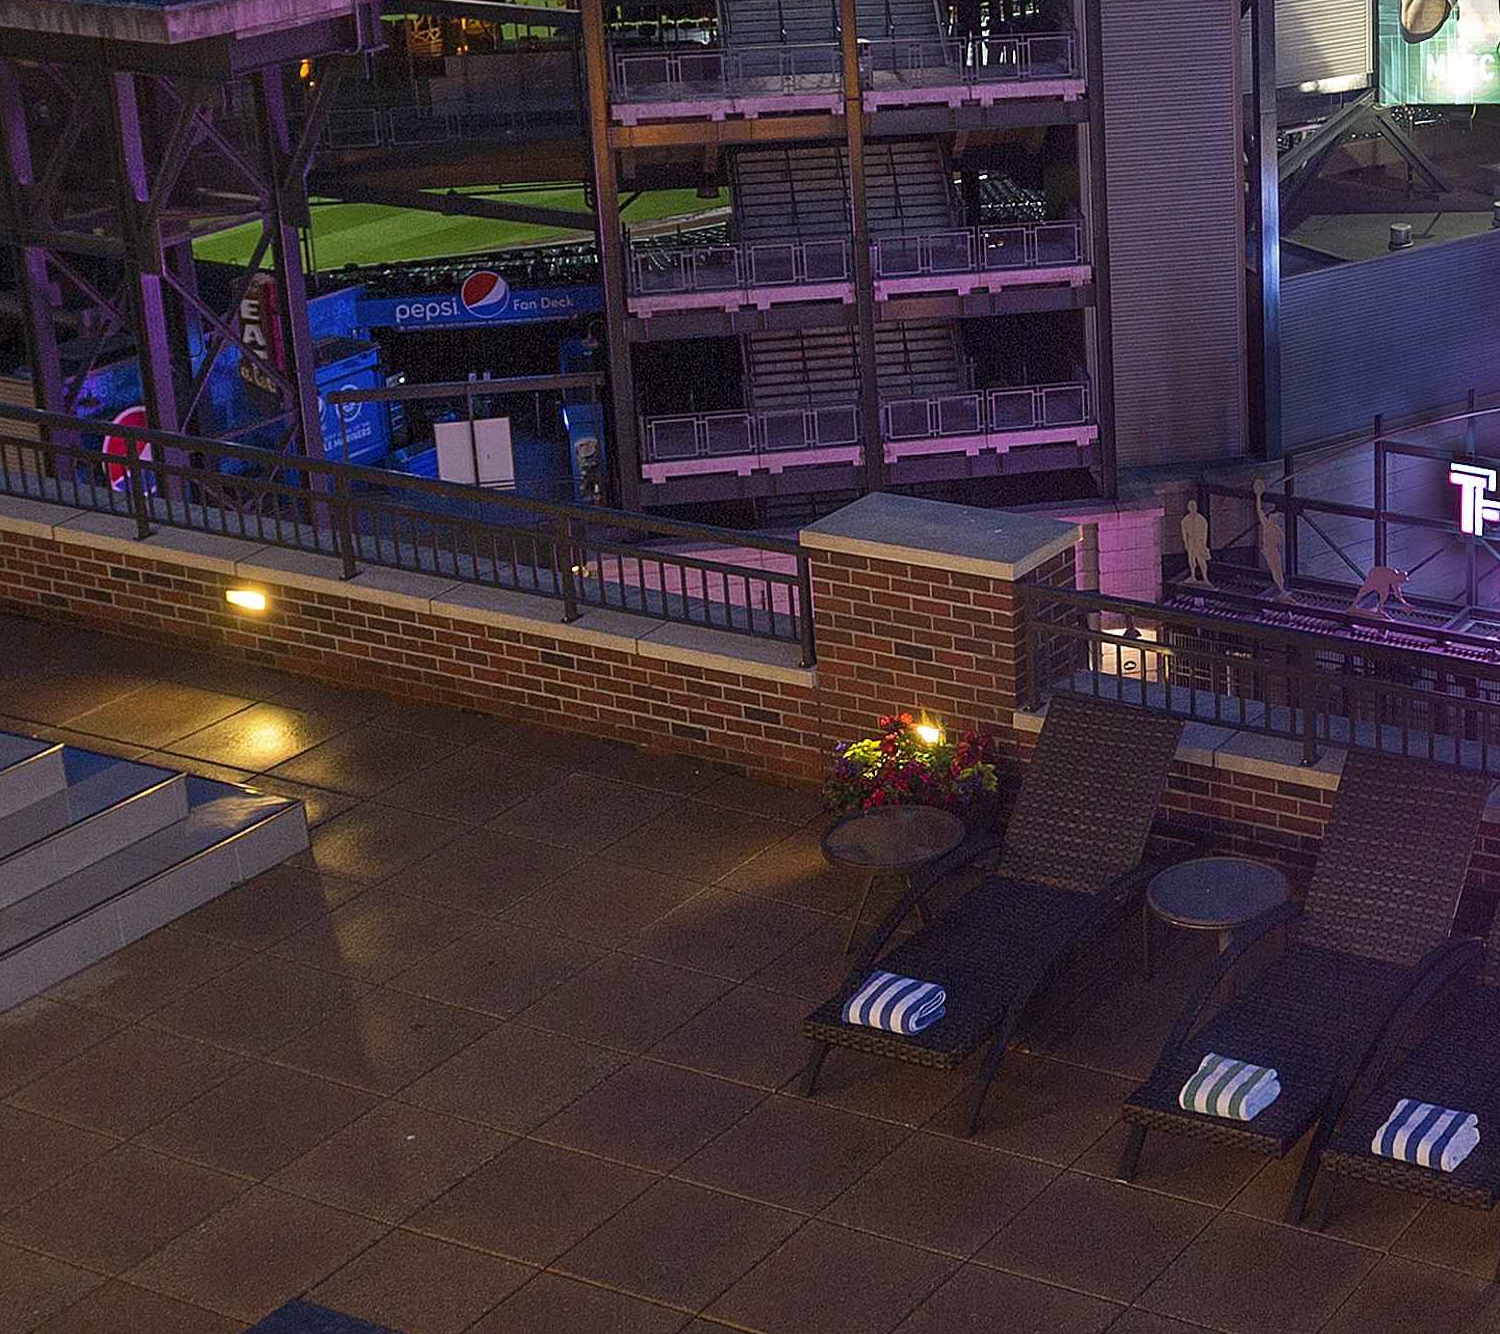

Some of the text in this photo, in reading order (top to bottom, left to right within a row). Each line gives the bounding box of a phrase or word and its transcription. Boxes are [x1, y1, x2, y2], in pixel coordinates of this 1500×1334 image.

[395, 297, 459, 324] pepsi
[513, 299, 537, 312] Fan
[541, 296, 574, 309] Deck
